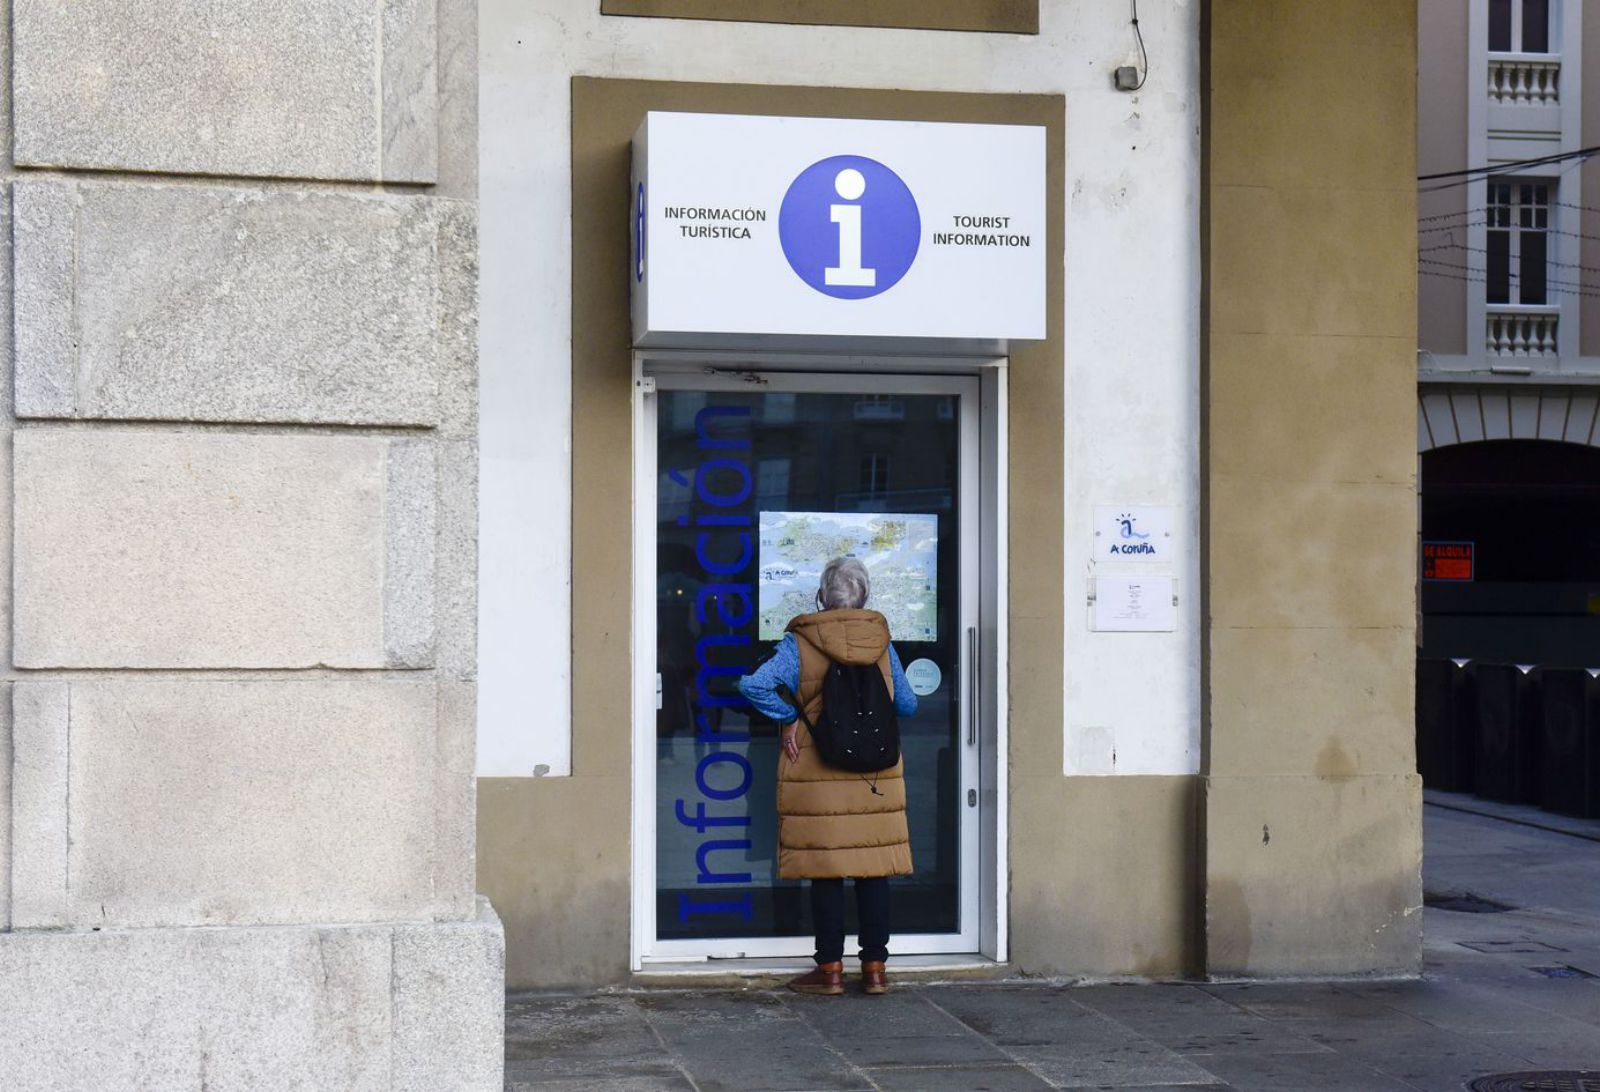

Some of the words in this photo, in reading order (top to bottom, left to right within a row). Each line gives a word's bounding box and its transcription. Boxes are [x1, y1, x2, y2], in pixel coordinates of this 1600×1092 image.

[664, 206, 766, 222] INFORMACIÓN
[953, 215, 1011, 229] TOURIST
[679, 223, 752, 239] TURÍSTICA
[933, 233, 1030, 247] INFORMATION
[1111, 545, 1119, 554] A
[669, 405, 752, 924] Información
